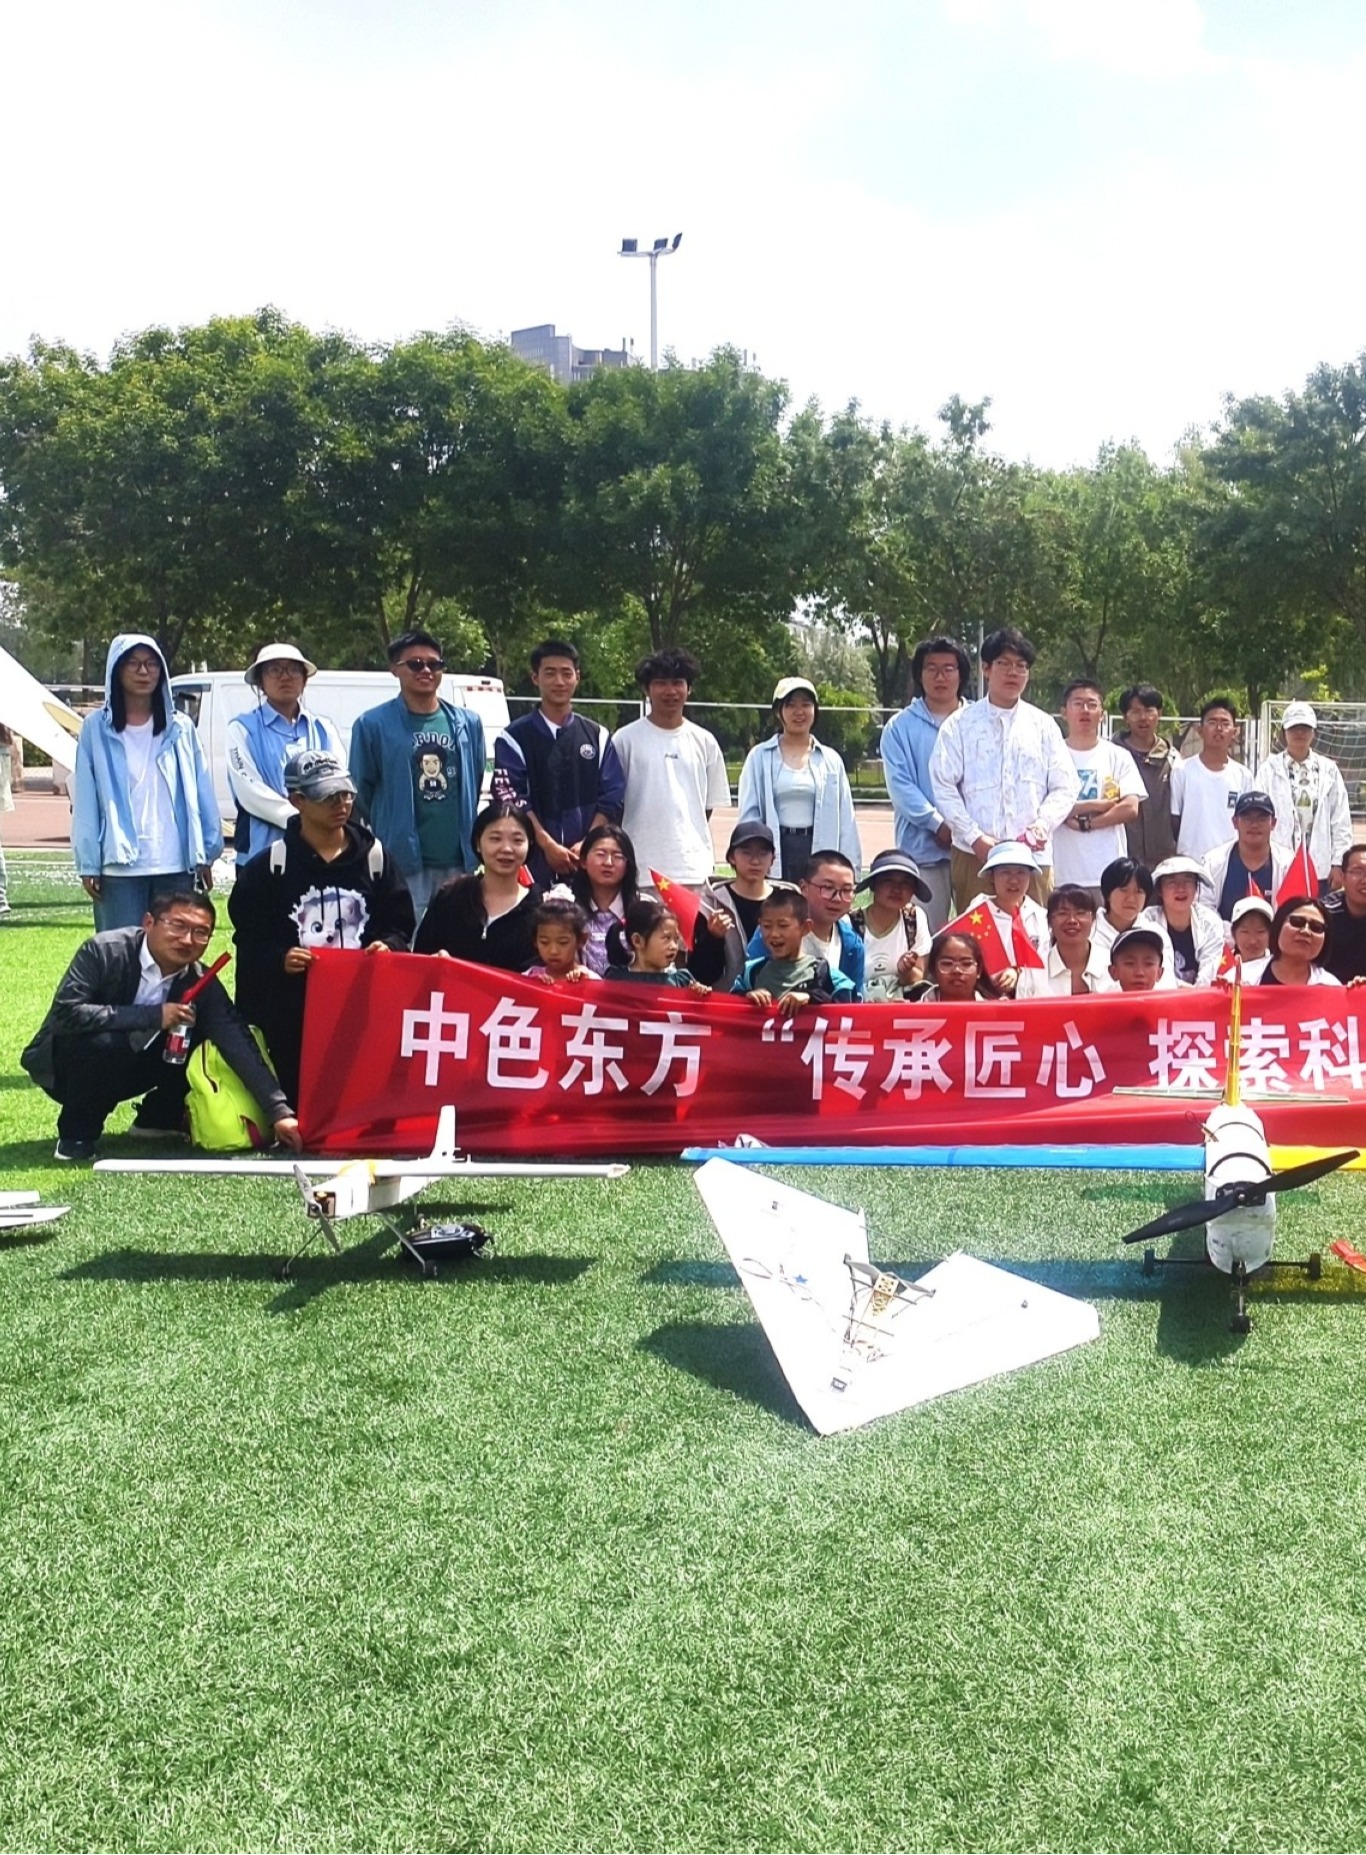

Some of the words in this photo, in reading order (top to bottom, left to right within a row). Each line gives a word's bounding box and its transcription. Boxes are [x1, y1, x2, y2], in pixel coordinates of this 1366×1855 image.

[401, 991, 712, 1097] 中色东方
[761, 1016, 1106, 1100] “传承匠心
